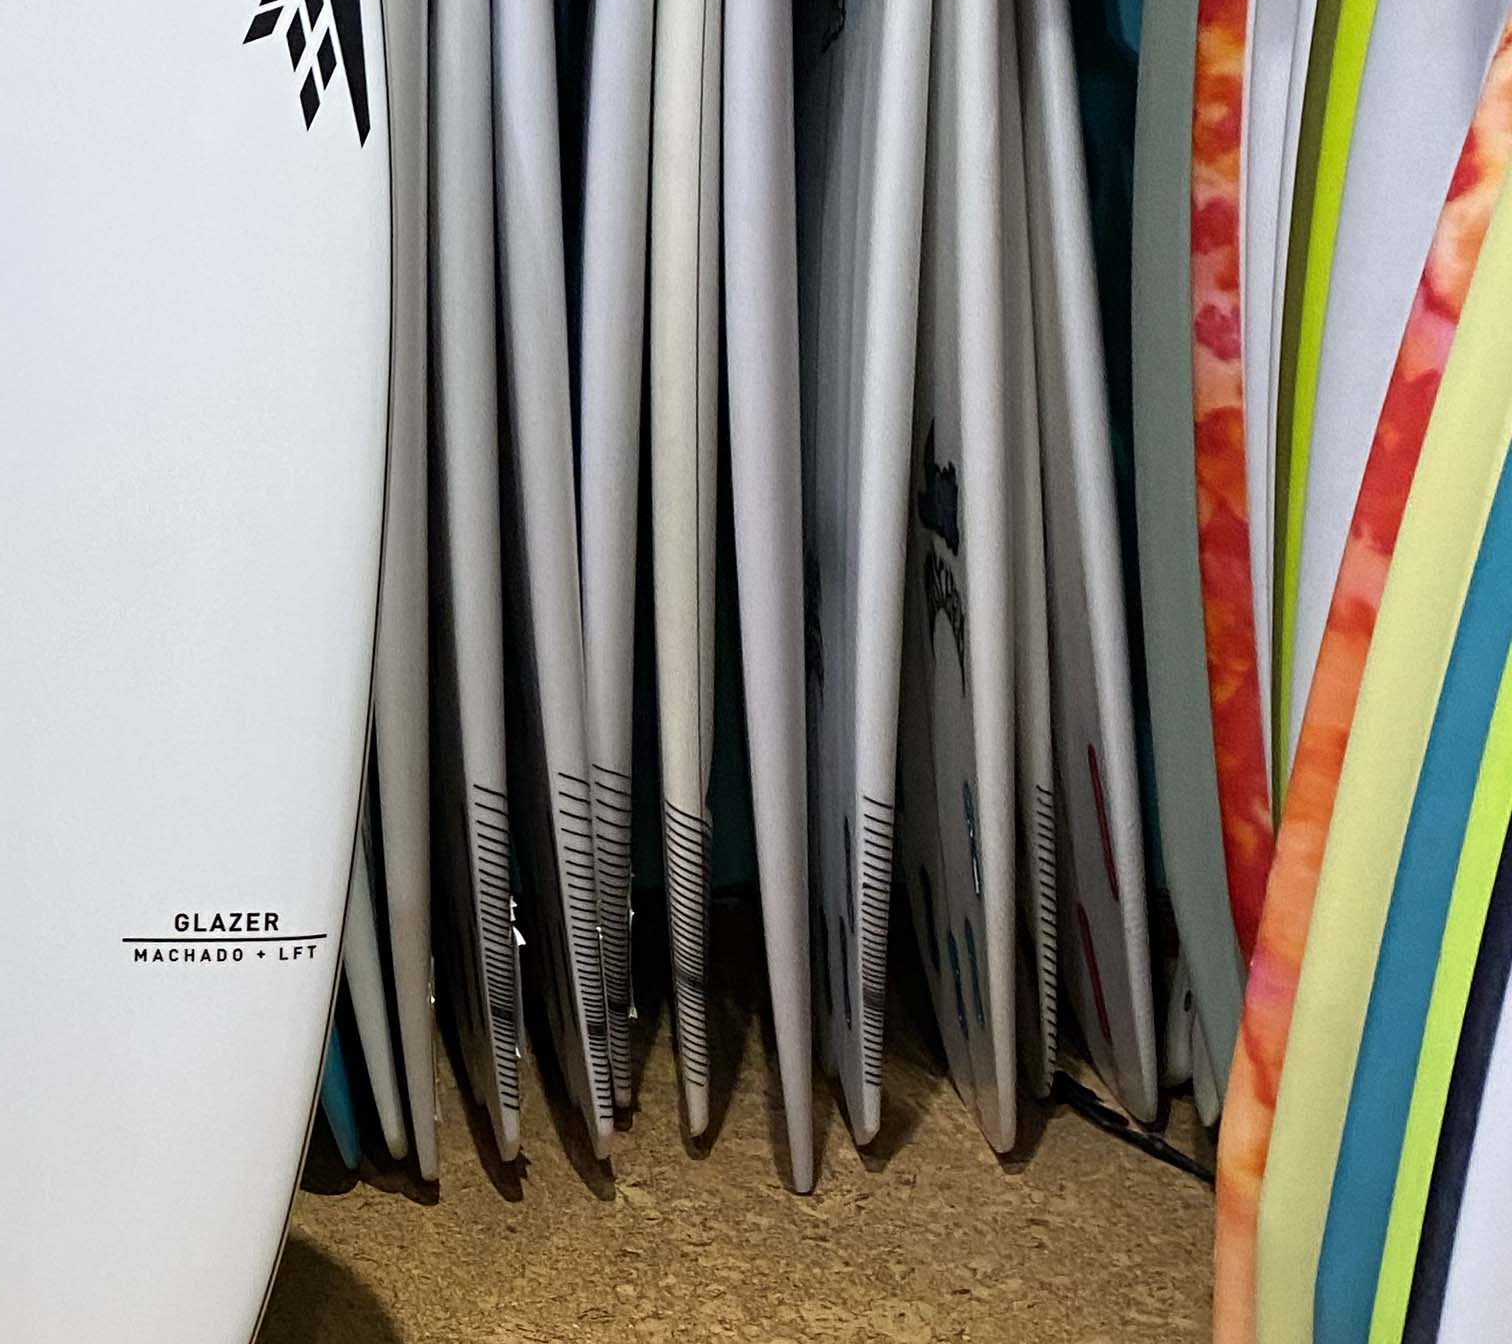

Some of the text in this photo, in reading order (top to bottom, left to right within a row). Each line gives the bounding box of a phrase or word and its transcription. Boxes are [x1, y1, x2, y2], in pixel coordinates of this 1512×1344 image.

[174, 912, 280, 932] GLAZER
[134, 947, 244, 962] MACHADO
[279, 944, 318, 961] LFT
